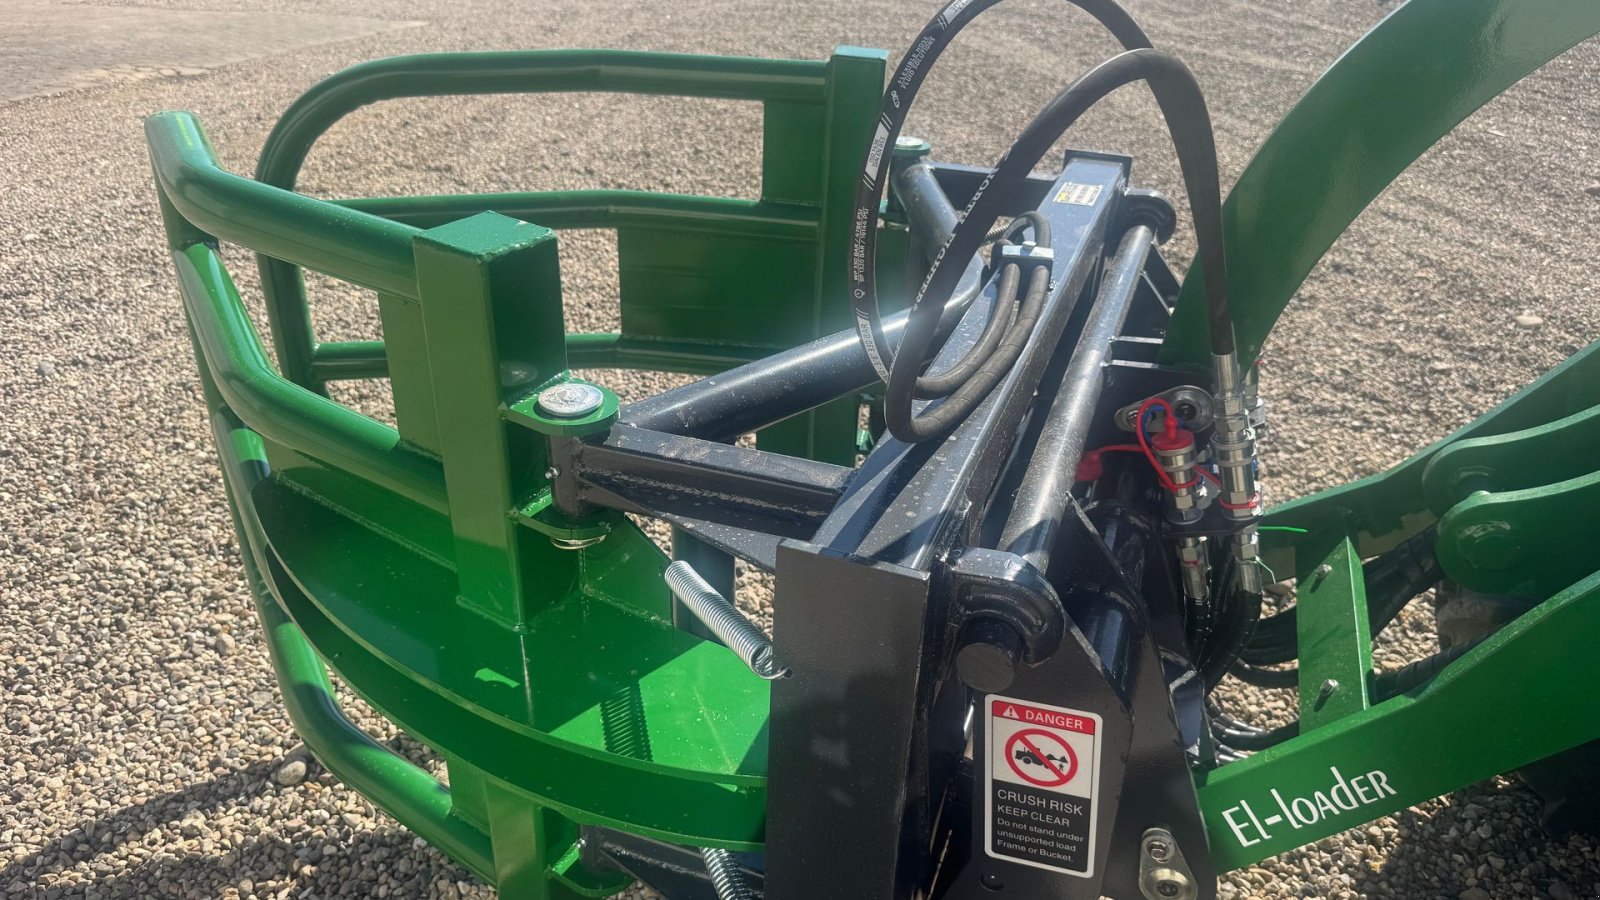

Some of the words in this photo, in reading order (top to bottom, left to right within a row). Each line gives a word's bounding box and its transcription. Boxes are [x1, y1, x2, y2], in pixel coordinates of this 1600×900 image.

[897, 52, 917, 83] FLEXIBLE
[900, 69, 914, 88] FLUID
[912, 36, 935, 70] SOLUTIONS
[957, 168, 999, 225] NORTH
[861, 324, 871, 338] BAR
[865, 341, 876, 352] 330
[1025, 710, 1083, 729] DANGER
[998, 790, 1046, 808] CRUSH
[1050, 801, 1083, 816] RISK
[998, 805, 1028, 817] KEEP
[1031, 813, 1070, 827] CLEAR
[998, 818, 1010, 827] Do
[1013, 821, 1026, 830] not
[1029, 825, 1054, 836] stand
[1057, 830, 1084, 842] under
[998, 830, 1054, 847] unsupported
[1056, 841, 1076, 851] load
[998, 839, 1025, 851] Frame
[1040, 849, 1074, 862] Bucket.
